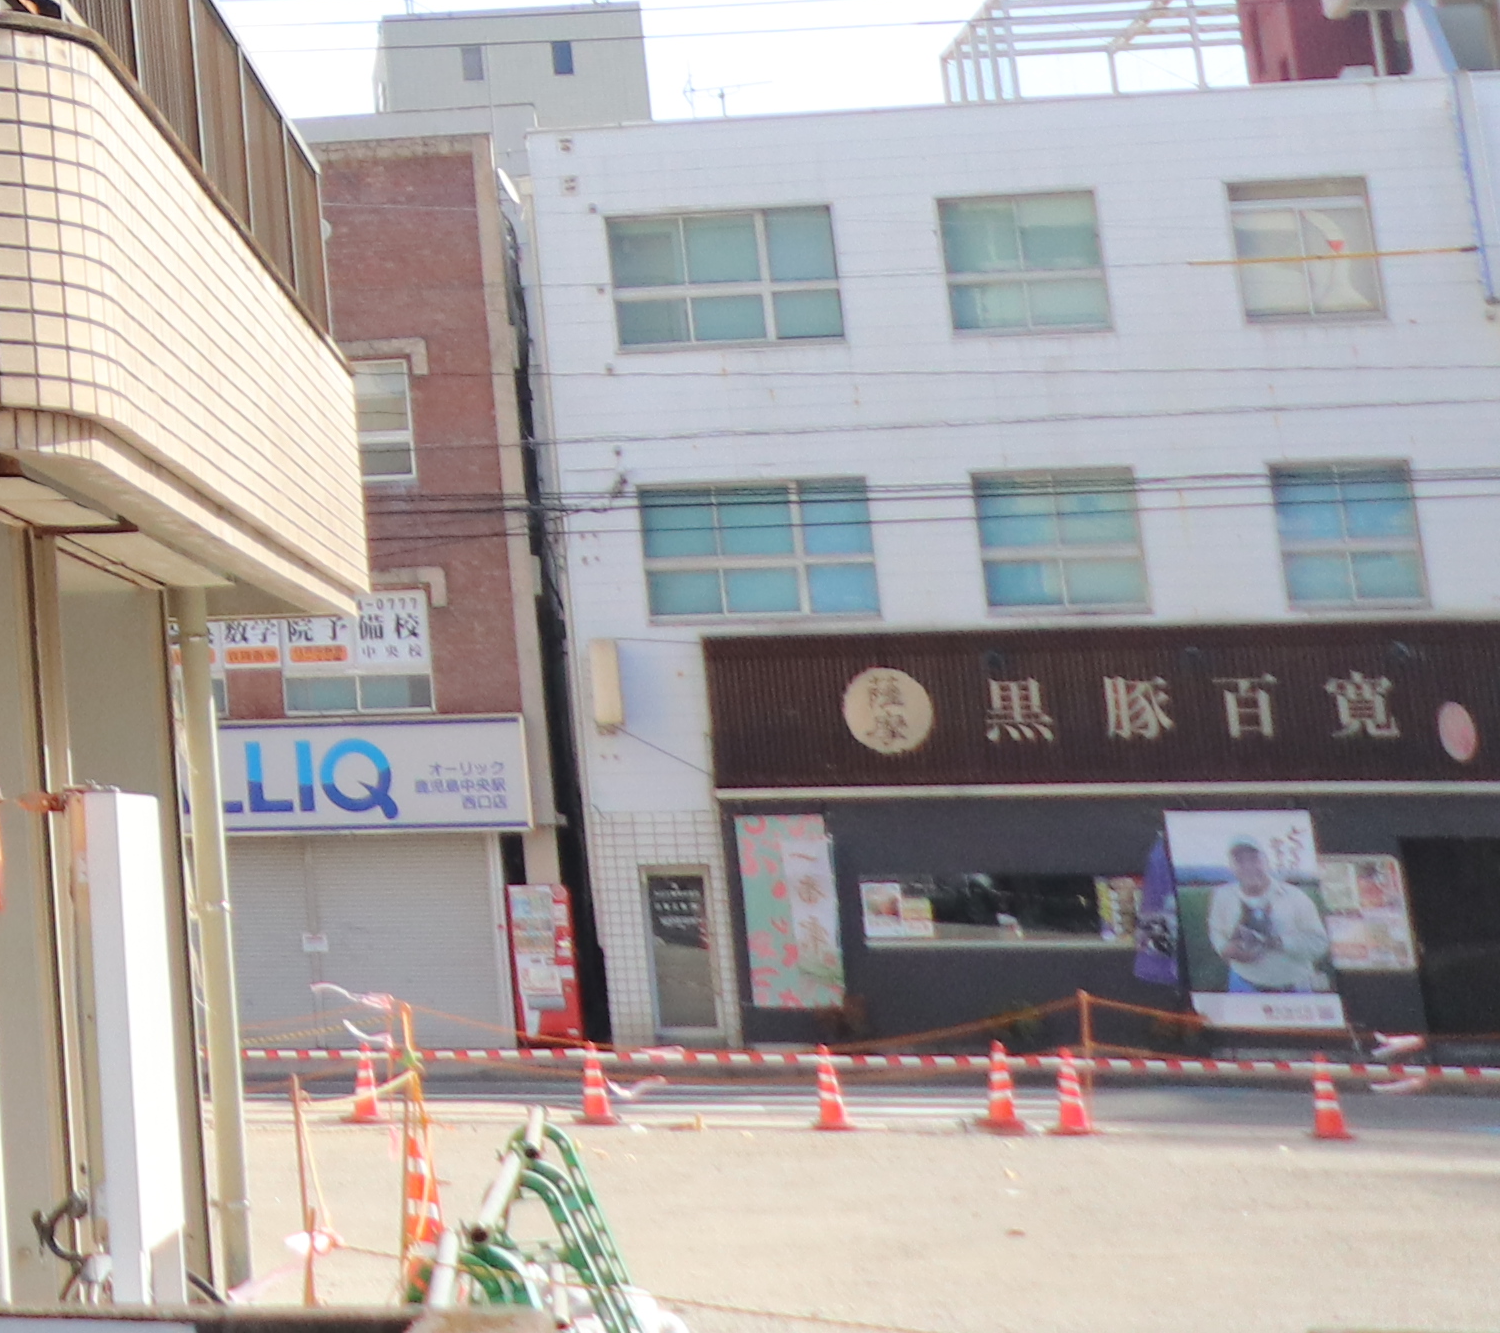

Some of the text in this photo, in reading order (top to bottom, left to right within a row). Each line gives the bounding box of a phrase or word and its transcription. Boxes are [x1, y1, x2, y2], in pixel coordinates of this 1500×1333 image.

[428, 760, 505, 776] オーリック
